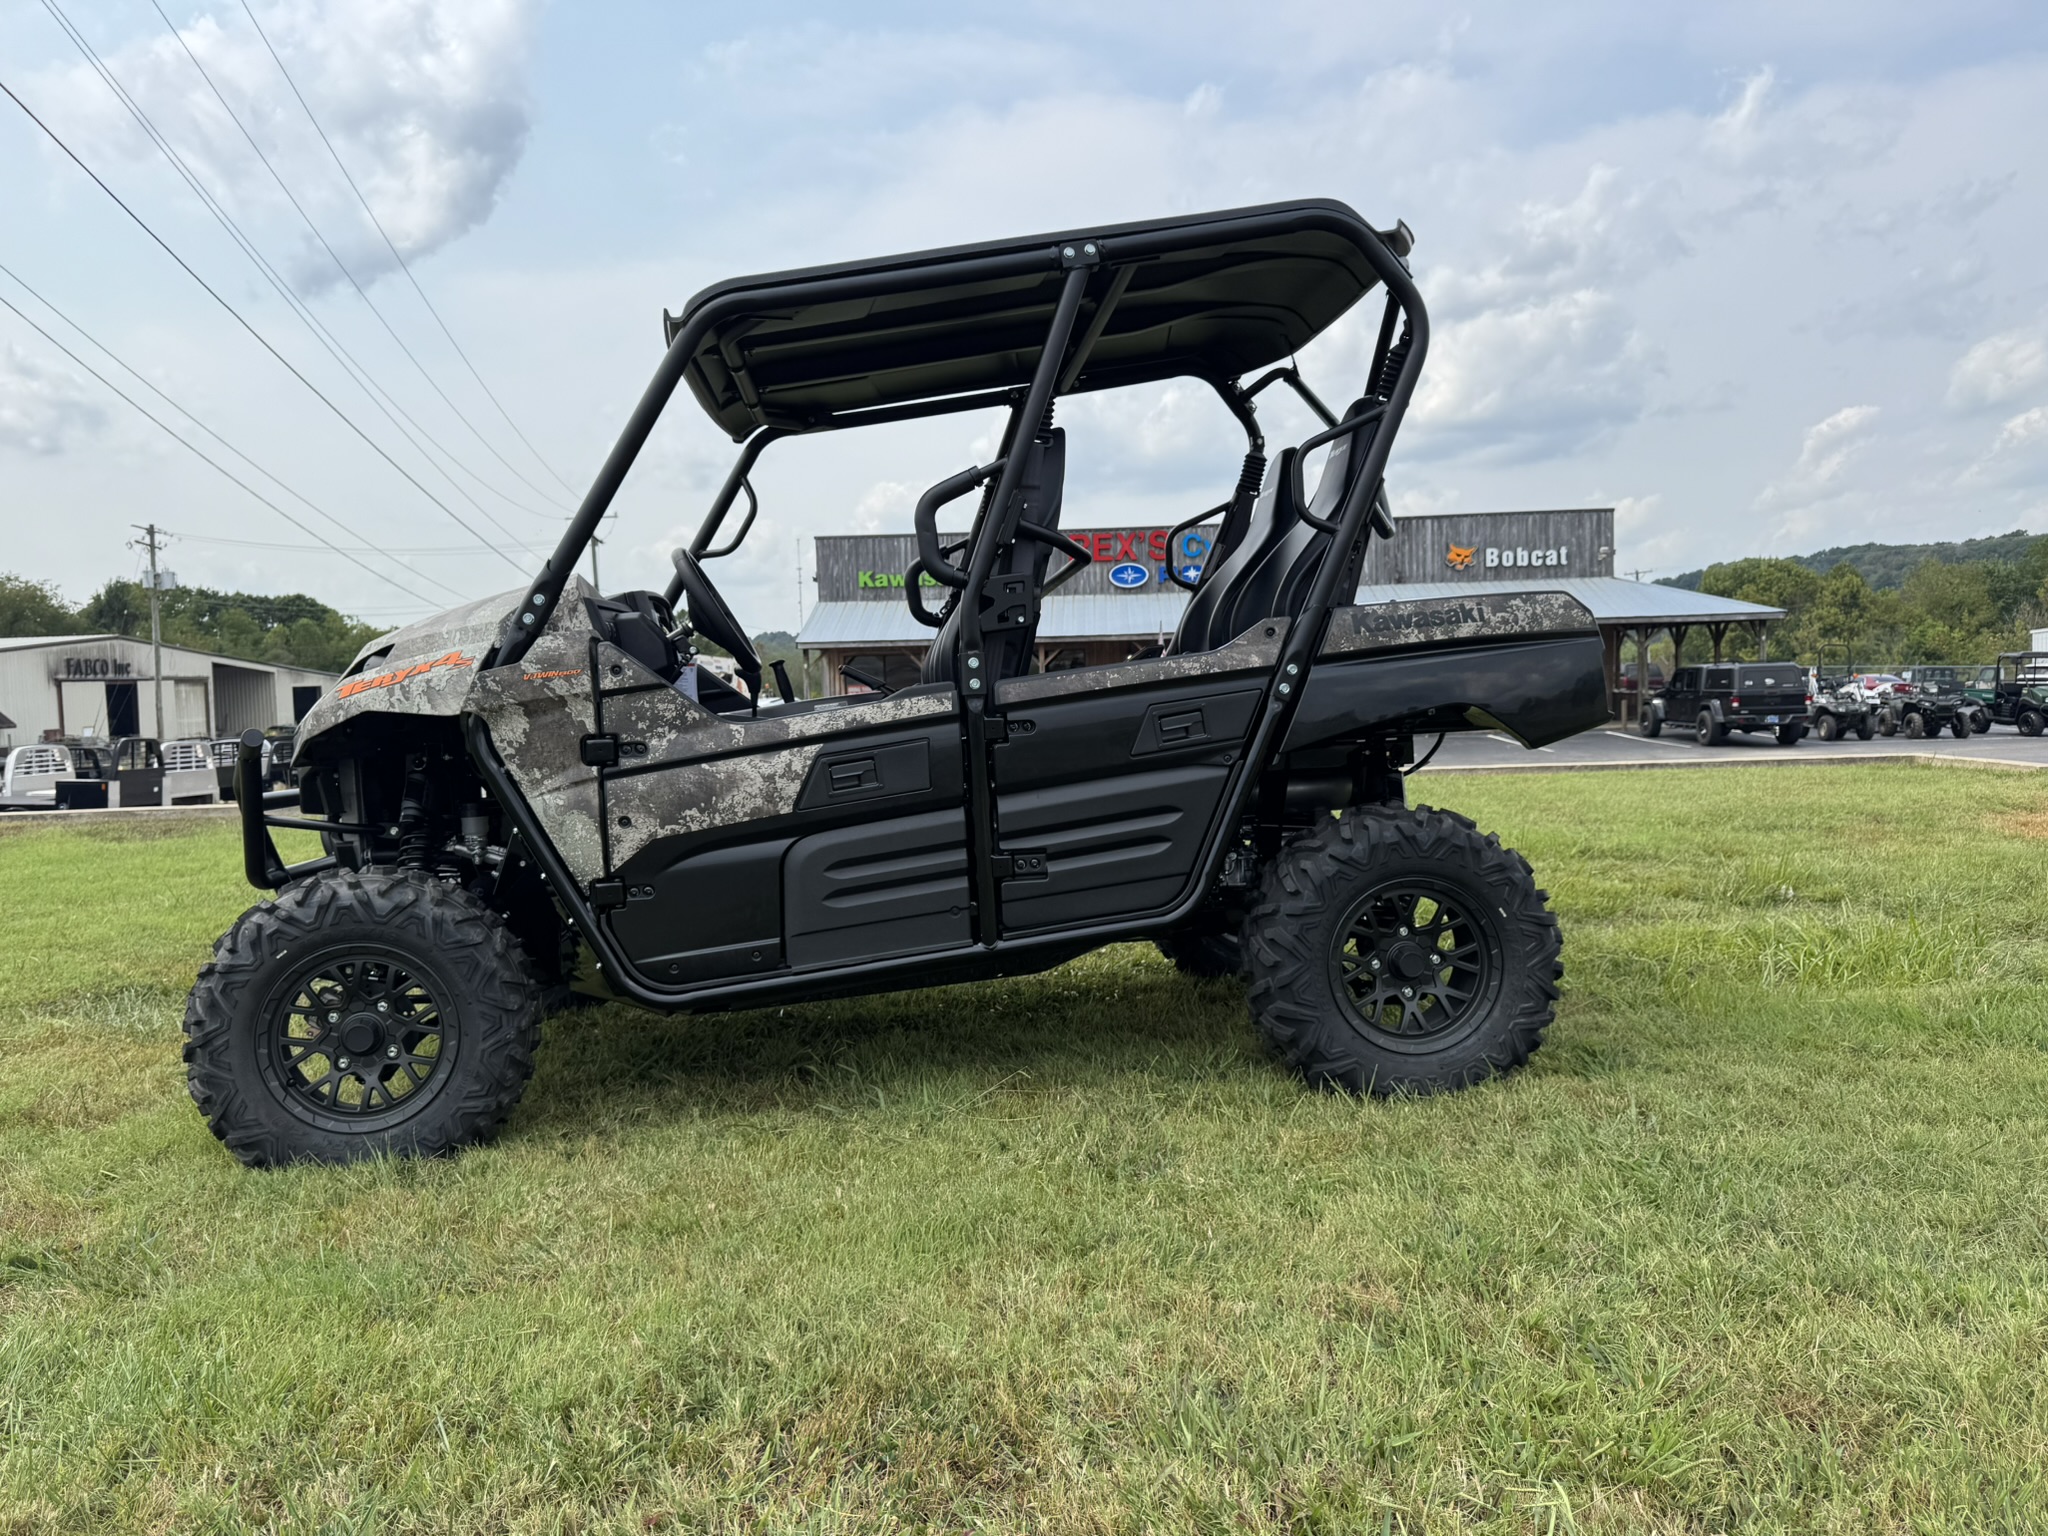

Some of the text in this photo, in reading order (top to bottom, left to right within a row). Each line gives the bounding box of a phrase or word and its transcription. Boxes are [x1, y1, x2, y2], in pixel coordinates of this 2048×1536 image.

[1485, 545, 1568, 568] Bobcat
[1351, 602, 1486, 635] Kawasaki
[66, 658, 131, 676] FABCO Inc
